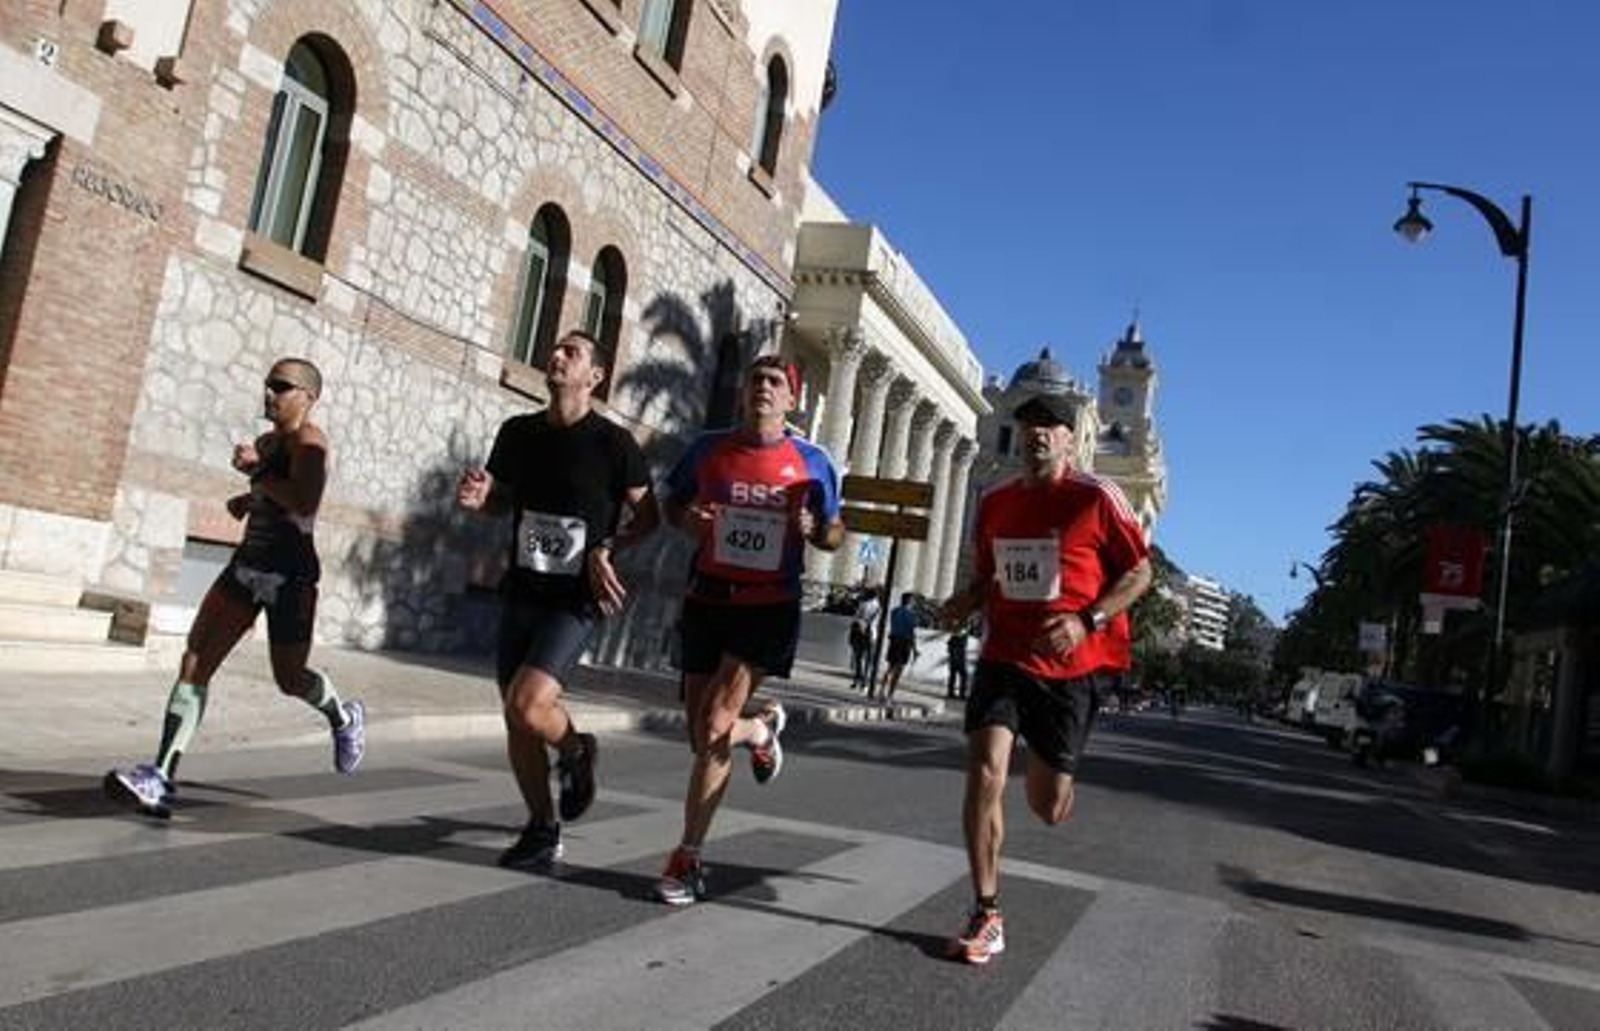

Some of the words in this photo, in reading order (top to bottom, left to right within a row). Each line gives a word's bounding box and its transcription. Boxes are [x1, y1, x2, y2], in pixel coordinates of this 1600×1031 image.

[40, 44, 55, 65] 2
[725, 528, 766, 551] 420
[1005, 561, 1039, 582] 184
